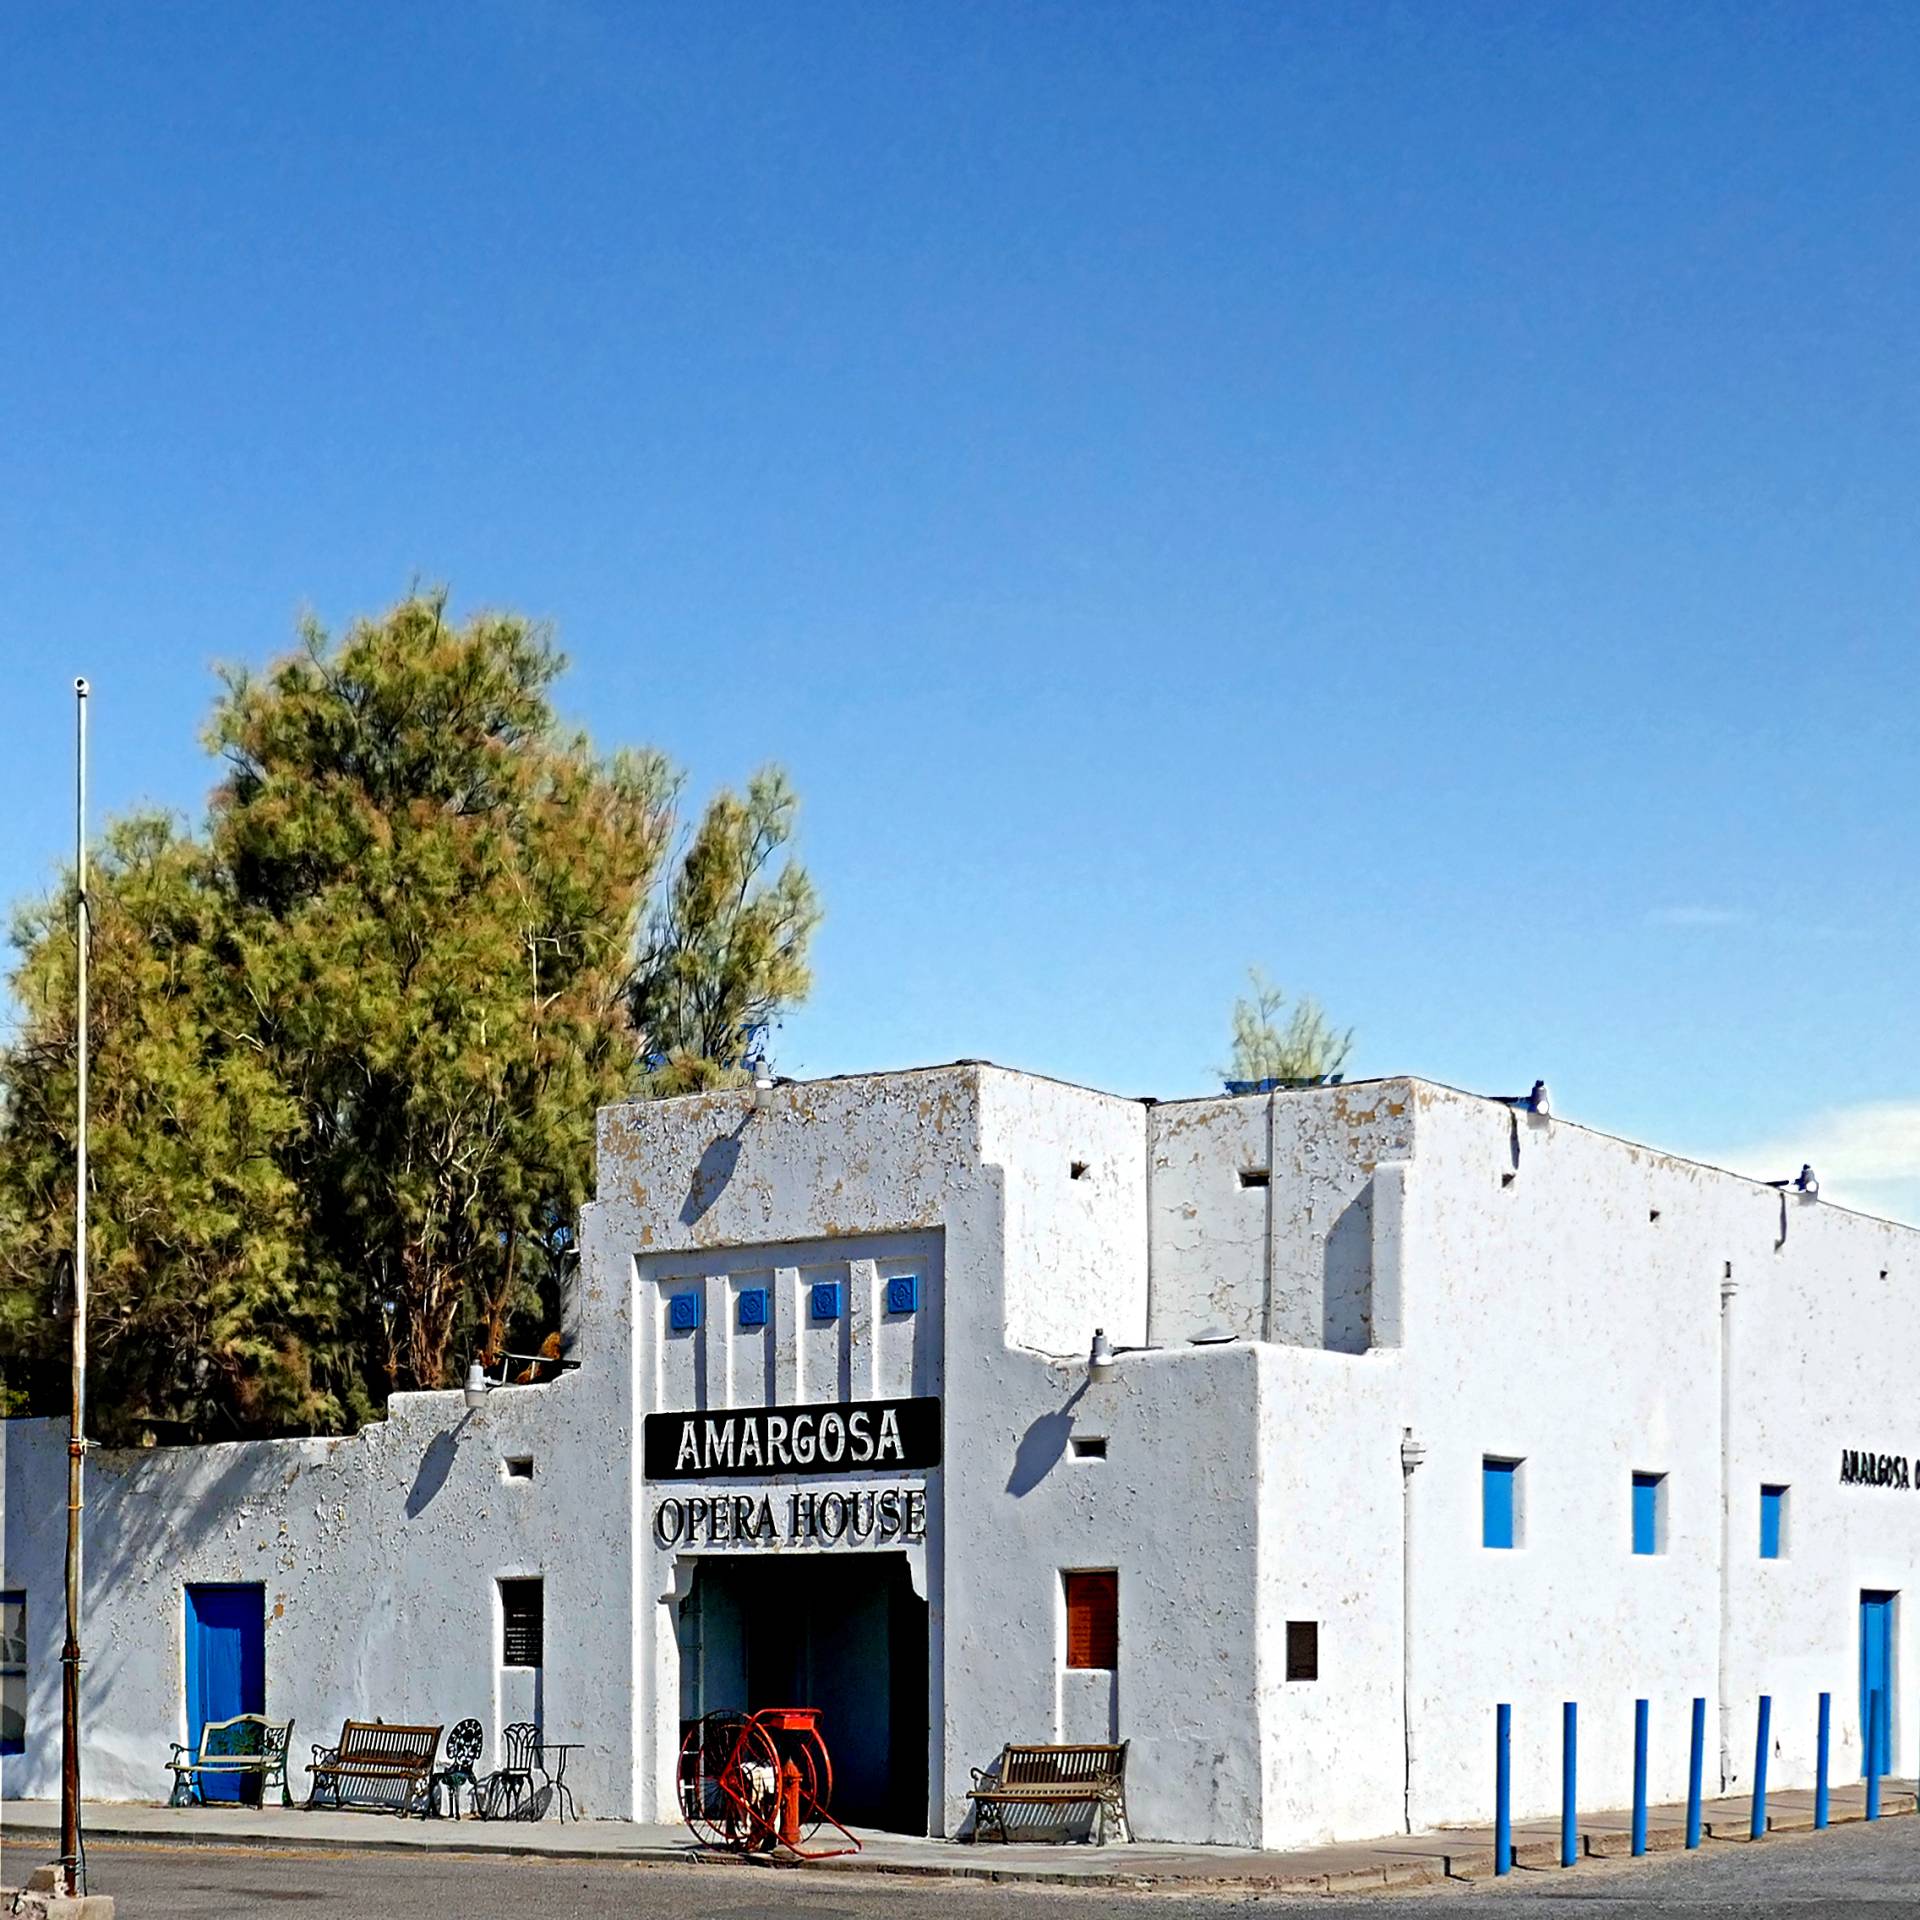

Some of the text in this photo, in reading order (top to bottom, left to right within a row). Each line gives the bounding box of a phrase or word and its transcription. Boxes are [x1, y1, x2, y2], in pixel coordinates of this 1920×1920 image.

[675, 1409, 905, 1470] AMARGOSA
[657, 1486, 926, 1542] OPERA HOUSE
